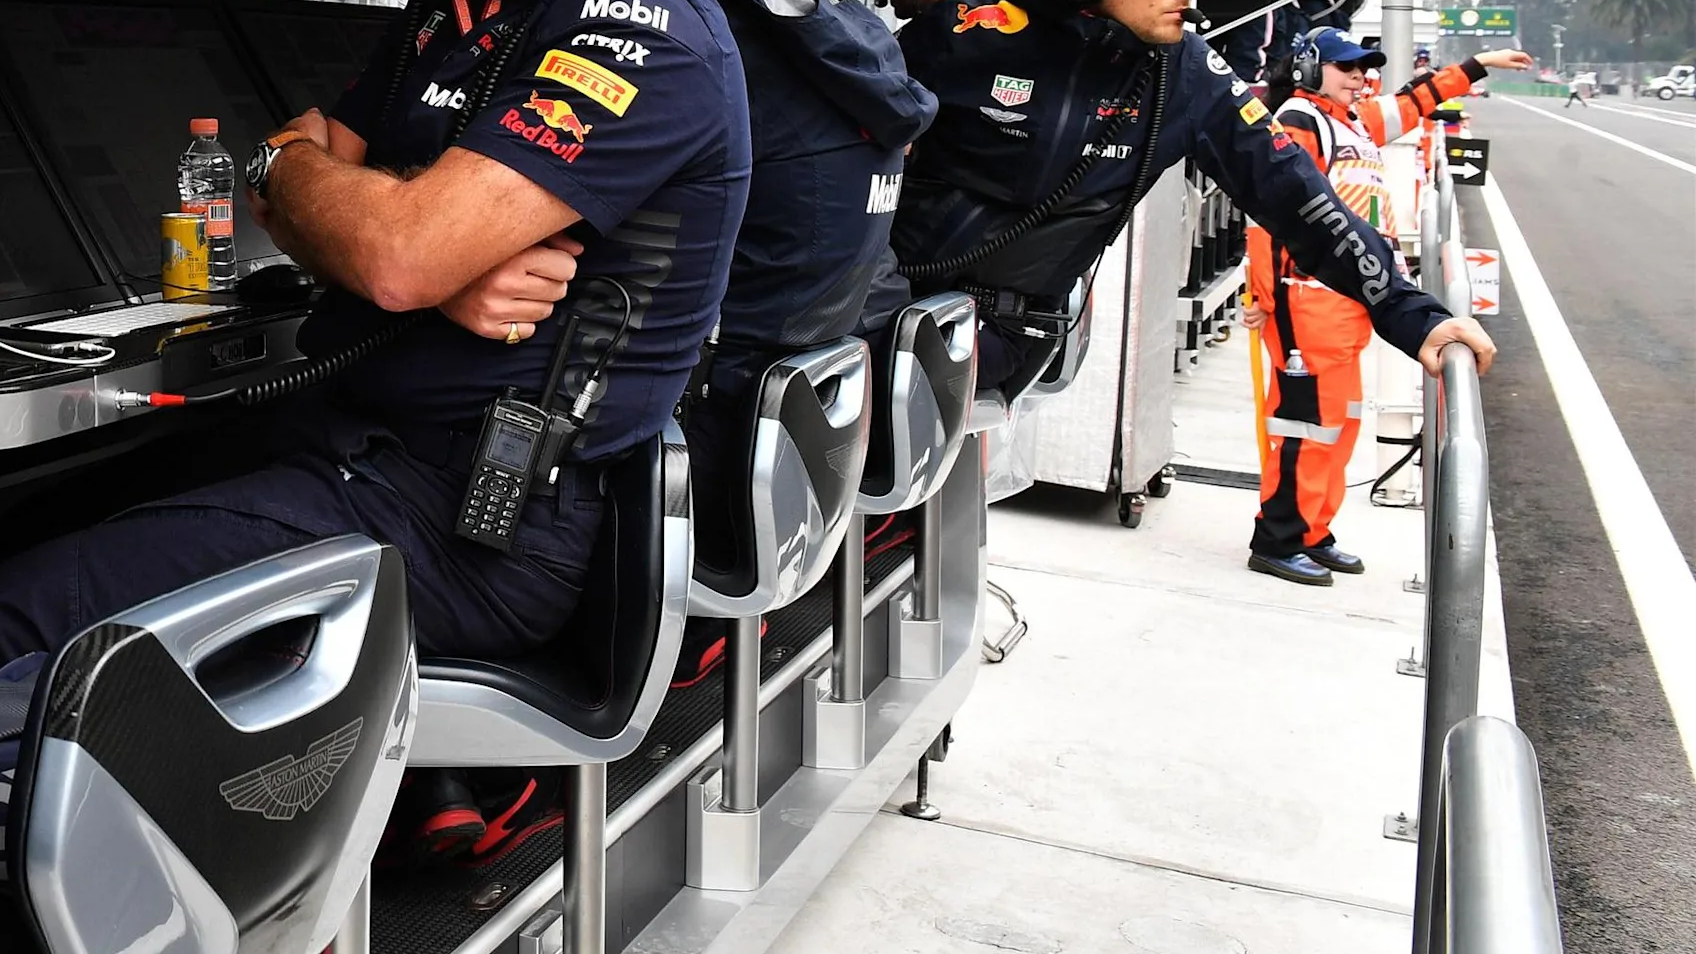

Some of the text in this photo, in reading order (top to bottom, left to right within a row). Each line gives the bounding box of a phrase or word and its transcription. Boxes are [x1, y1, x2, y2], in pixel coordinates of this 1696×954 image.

[544, 55, 626, 105] PIRELLI
[994, 88, 1029, 104] HEUER
[998, 78, 1031, 91] TAG
[499, 108, 584, 164] Red Bull
[1297, 192, 1390, 306] Red ull
[271, 750, 327, 787] ASTON MARTIN
